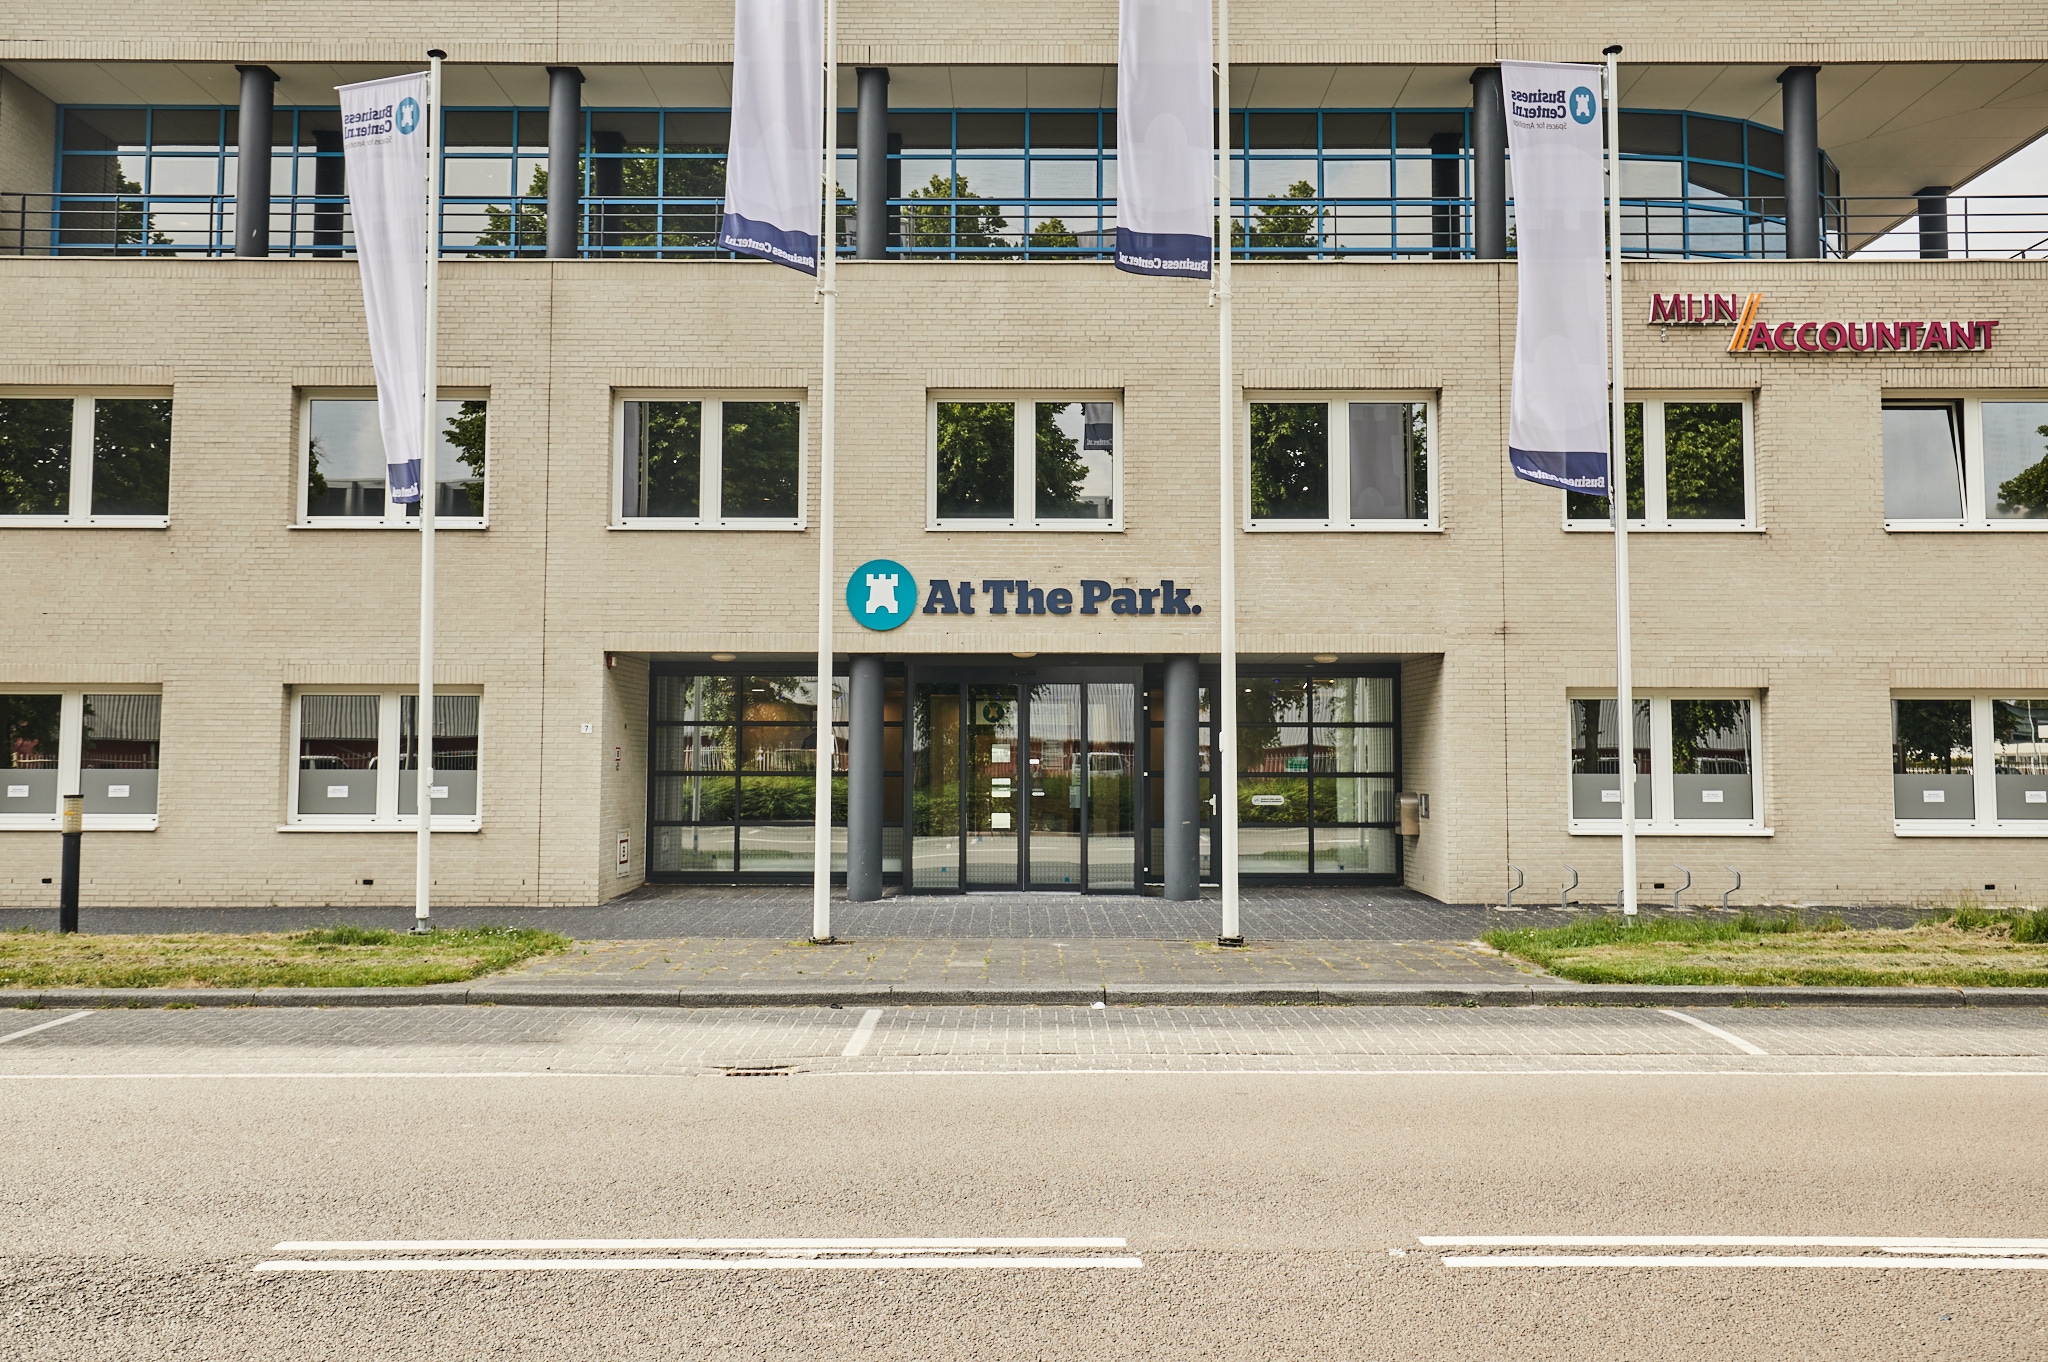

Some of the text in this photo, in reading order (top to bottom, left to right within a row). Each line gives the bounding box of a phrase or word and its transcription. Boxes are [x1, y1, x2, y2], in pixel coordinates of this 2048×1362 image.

[1651, 293, 1738, 323] MIJN
[1749, 320, 2000, 351] ACCOUNTANT
[922, 579, 1203, 615] At The Park.
